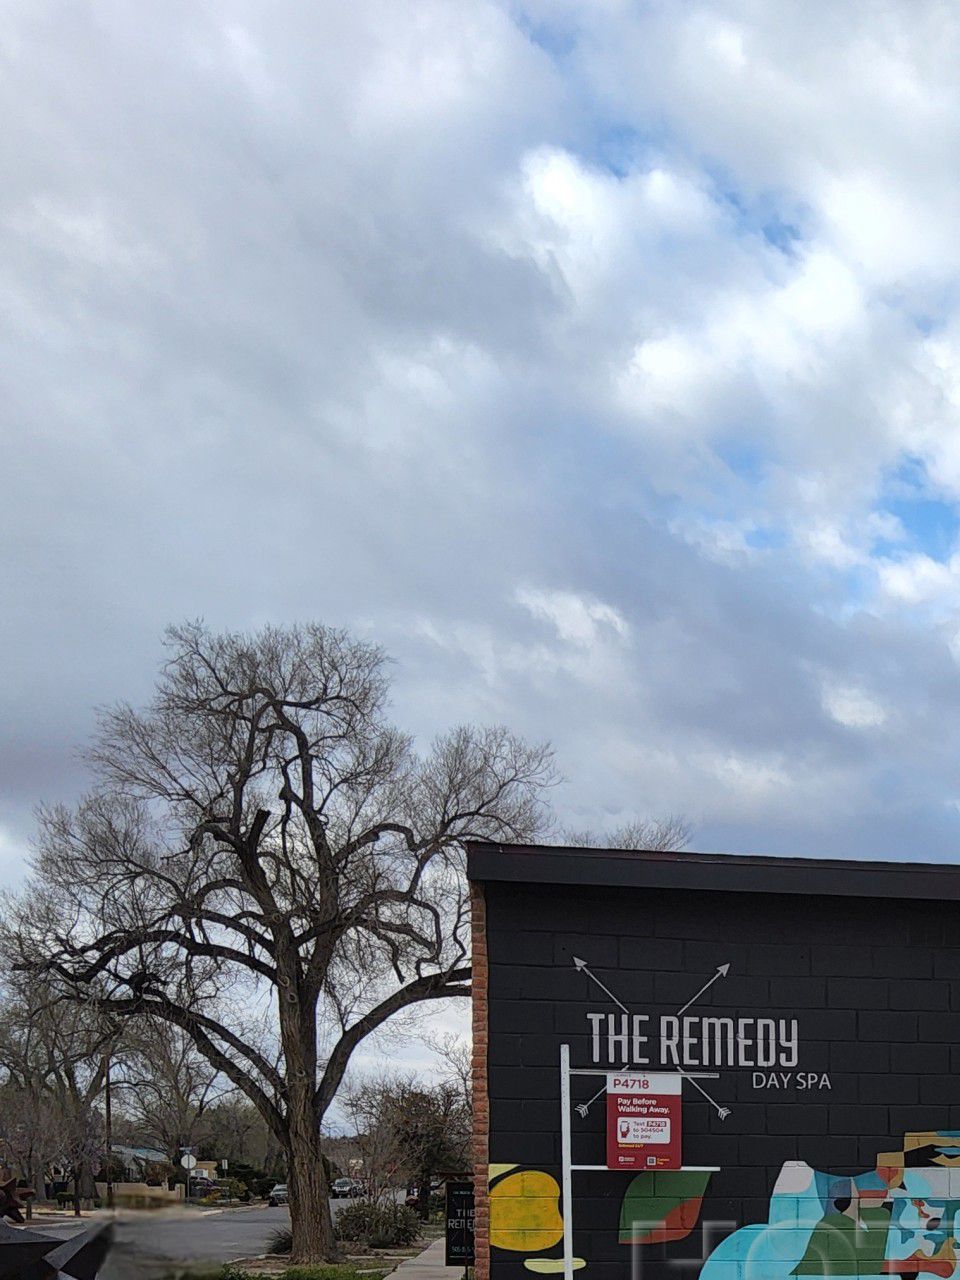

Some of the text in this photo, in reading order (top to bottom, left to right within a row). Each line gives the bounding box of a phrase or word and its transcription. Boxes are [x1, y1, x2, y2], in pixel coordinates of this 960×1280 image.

[587, 1013, 798, 1067] THE REMEDY
[613, 1079, 649, 1089] P4718
[753, 1073, 831, 1089] DAY SPA
[618, 1098, 631, 1106] Pay
